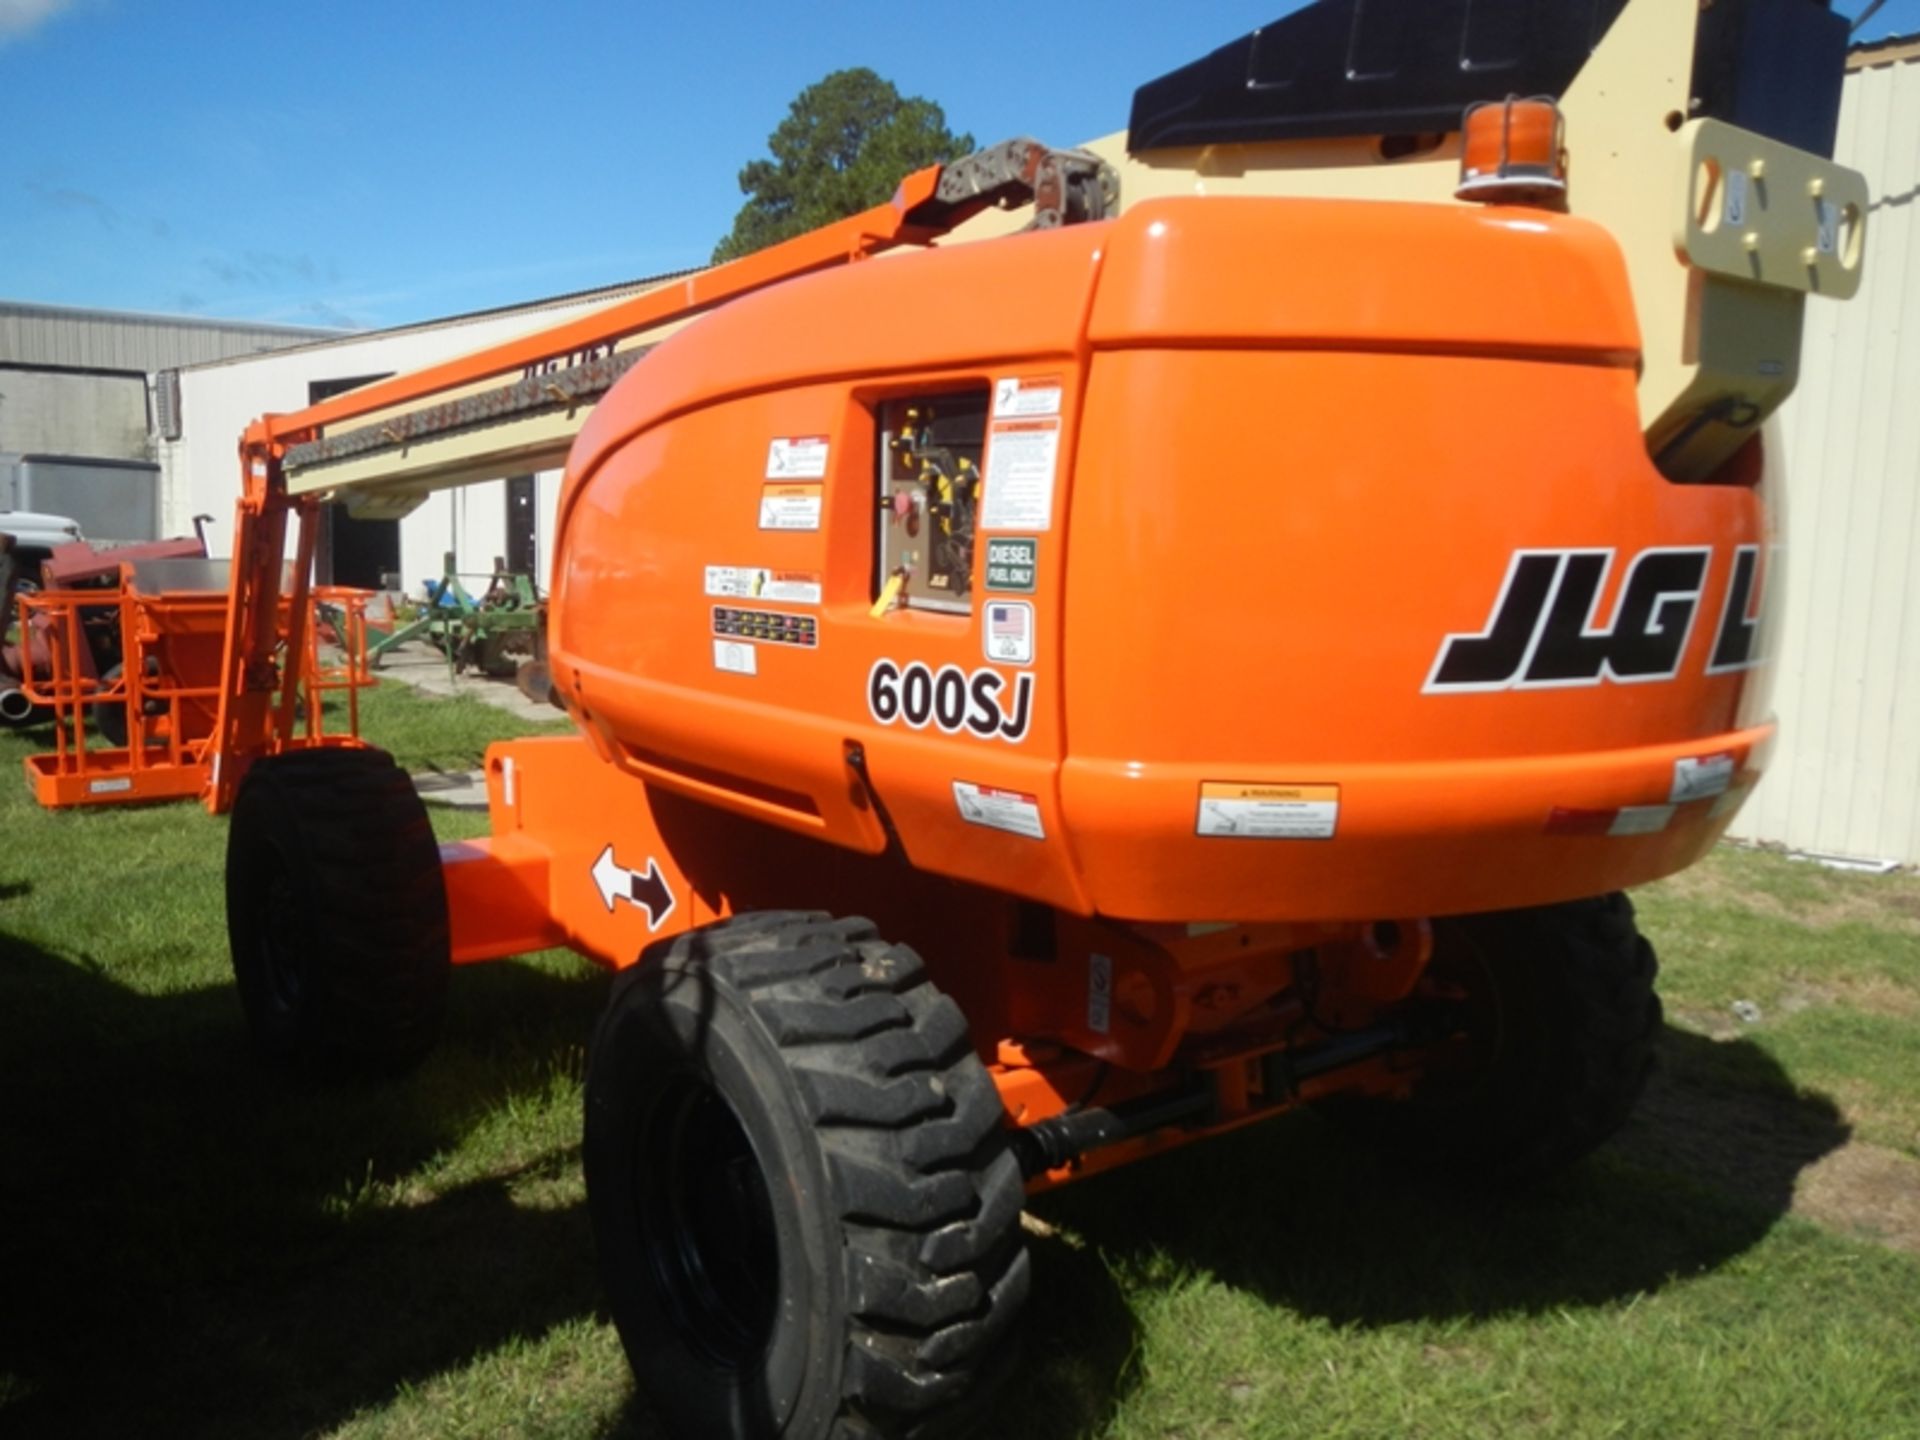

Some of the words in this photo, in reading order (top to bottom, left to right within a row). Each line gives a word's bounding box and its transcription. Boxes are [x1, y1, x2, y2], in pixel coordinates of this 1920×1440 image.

[989, 545, 1034, 565] DIESEL
[1424, 548, 1710, 691] JLG
[868, 659, 1034, 741] 600SJ
